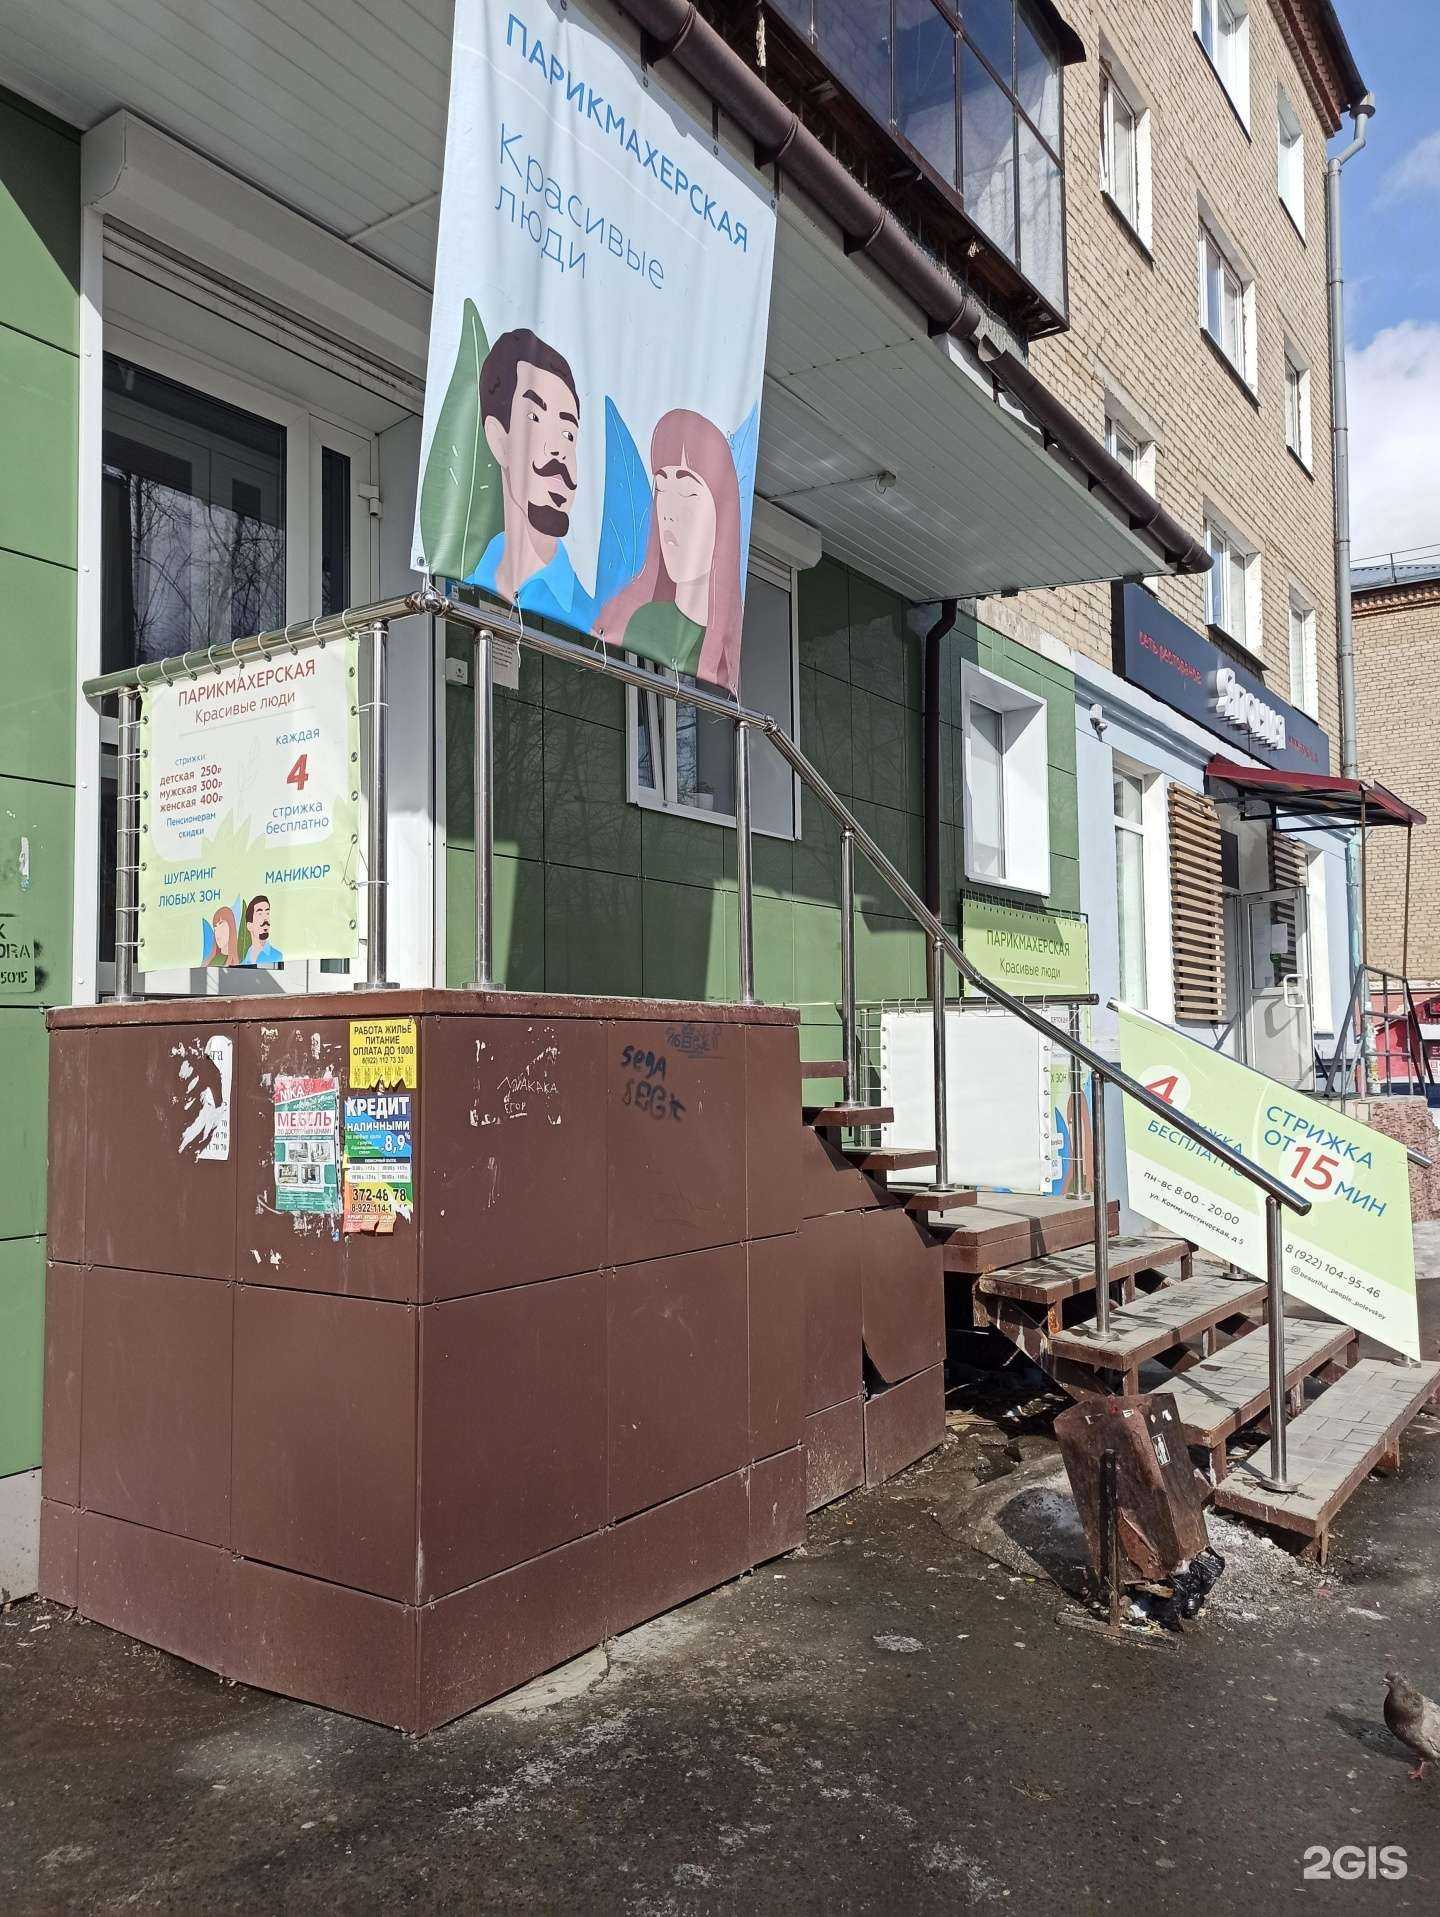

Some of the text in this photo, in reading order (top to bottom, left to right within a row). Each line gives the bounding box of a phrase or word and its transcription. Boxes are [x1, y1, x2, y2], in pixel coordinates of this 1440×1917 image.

[507, 13, 748, 252] ПАРИКМАХЕРСКАЯ
[500, 122, 664, 290] Красивые
[495, 185, 586, 279] люди
[178, 659, 316, 707] ПАРИКМАХЕРСКАЯ
[195, 690, 296, 725] Красивые люди
[275, 728, 321, 748] каждая
[159, 771, 195, 787] детская
[287, 754, 309, 791] 4
[159, 784, 198, 801] мужская
[160, 798, 197, 813] женская
[272, 801, 323, 822] стрижка
[167, 812, 217, 828] Пенсионерам
[265, 816, 330, 836] бесплатно
[164, 867, 217, 885] ШУГАРИНГ
[265, 863, 331, 885] МАНИКЮР
[159, 888, 221, 908] ЛЮБЫХ ЗОН
[986, 929, 1070, 957] ПАРИКМАХЕРСКАЯ
[1000, 957, 1061, 980] Красивые люди
[354, 1025, 383, 1035] РАБОТА
[365, 1035, 400, 1045] ПИТАНИЕ
[352, 1046, 383, 1056] ОПЛАТА
[384, 1046, 395, 1056] ДО
[1145, 1074, 1178, 1105] 4
[346, 1096, 410, 1120] КРЕДИТ
[347, 1121, 410, 1132] НАЛИЧНЫМИ
[1266, 1106, 1373, 1169] СТРИЖКА
[1264, 1128, 1298, 1153] ОТ
[1290, 1146, 1340, 1190] 15
[1335, 1181, 1387, 1217] МИН
[1174, 1186, 1199, 1204] 8:00
[1207, 1203, 1240, 1225] 20:00
[1285, 1243, 1382, 1298] 8 (922) 104-95-46
